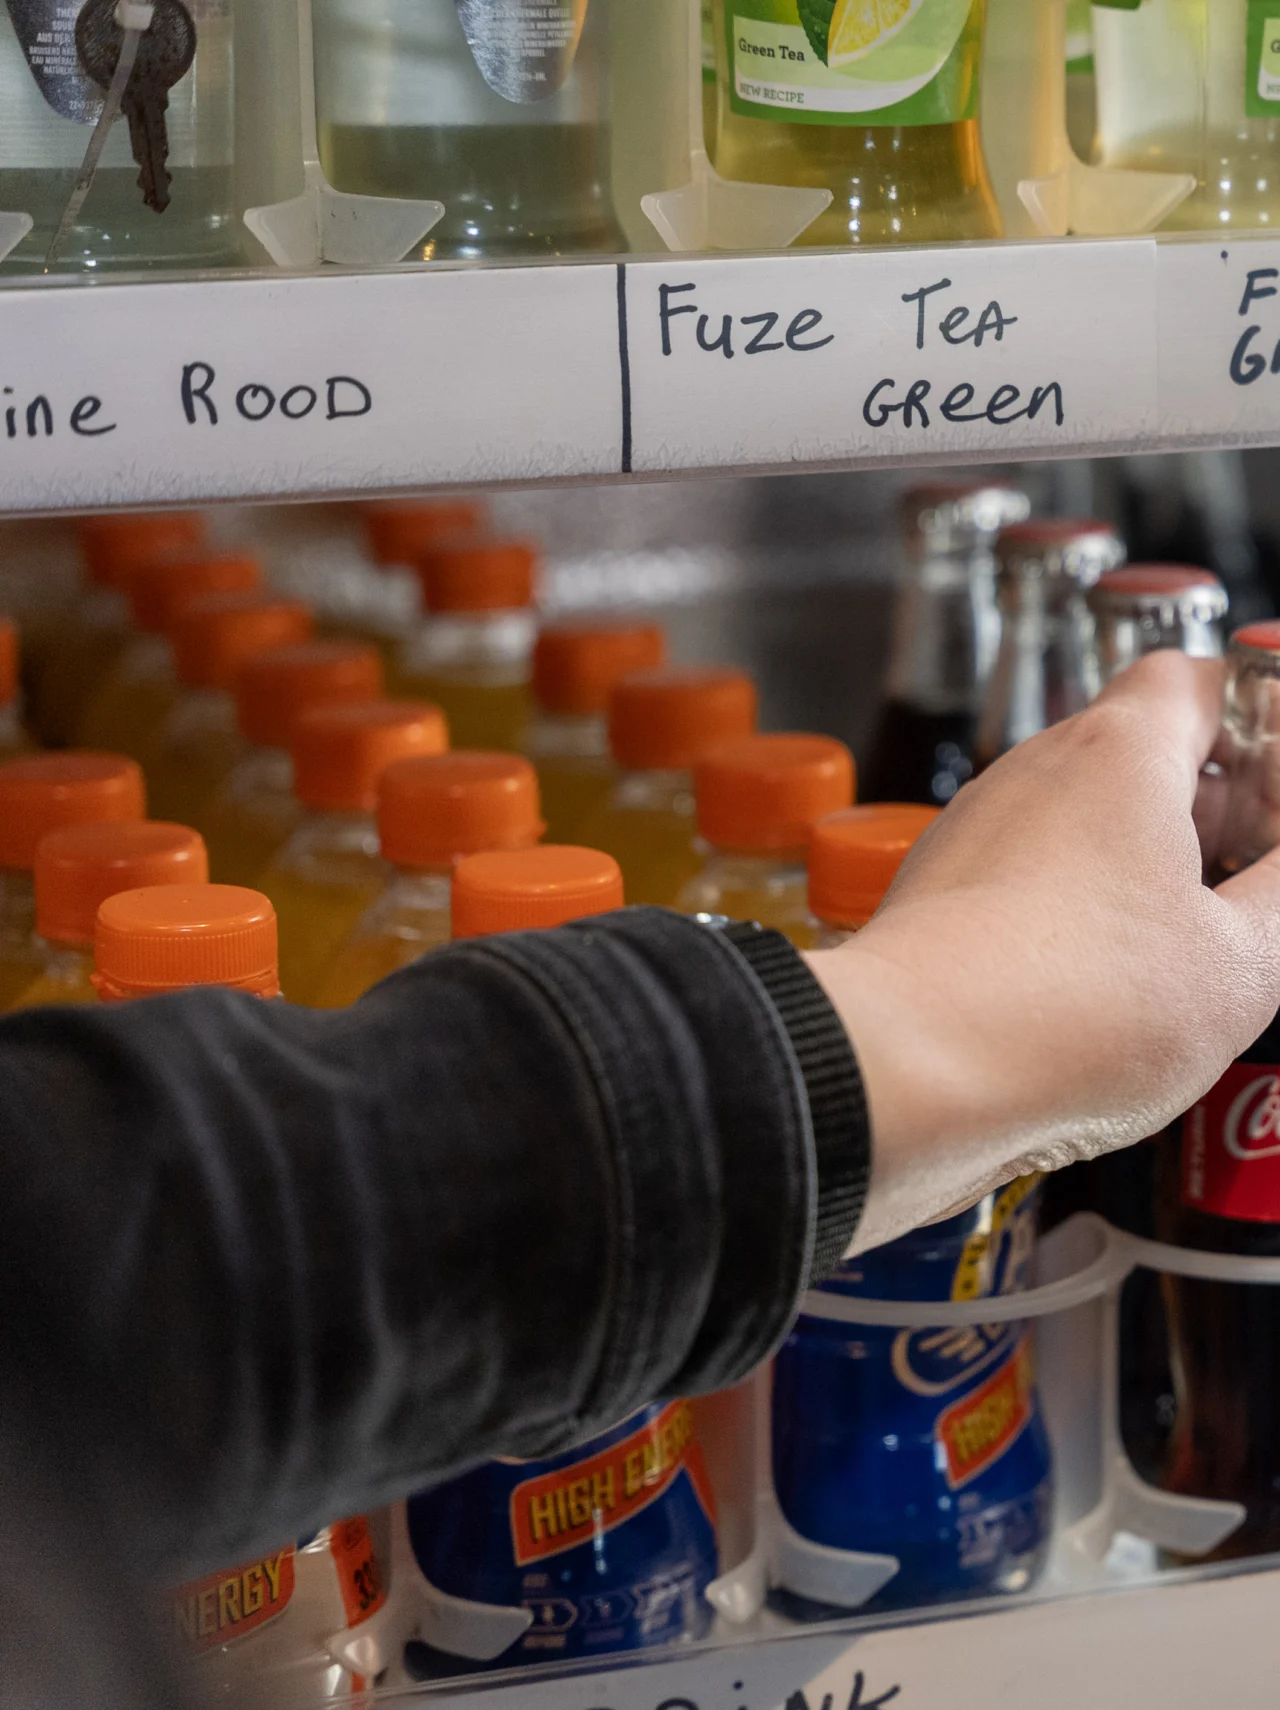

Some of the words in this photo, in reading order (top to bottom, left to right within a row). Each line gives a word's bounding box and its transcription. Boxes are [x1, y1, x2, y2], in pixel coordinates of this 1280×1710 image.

[738, 37, 775, 58] Green
[778, 45, 805, 62] Tea
[739, 82, 760, 96] NEW
[763, 87, 804, 104] RECIPE
[657, 282, 835, 360] Fuze
[1, 386, 118, 439] ine
[528, 1464, 615, 1544] HIGH
[172, 1550, 284, 1638] NERGY
